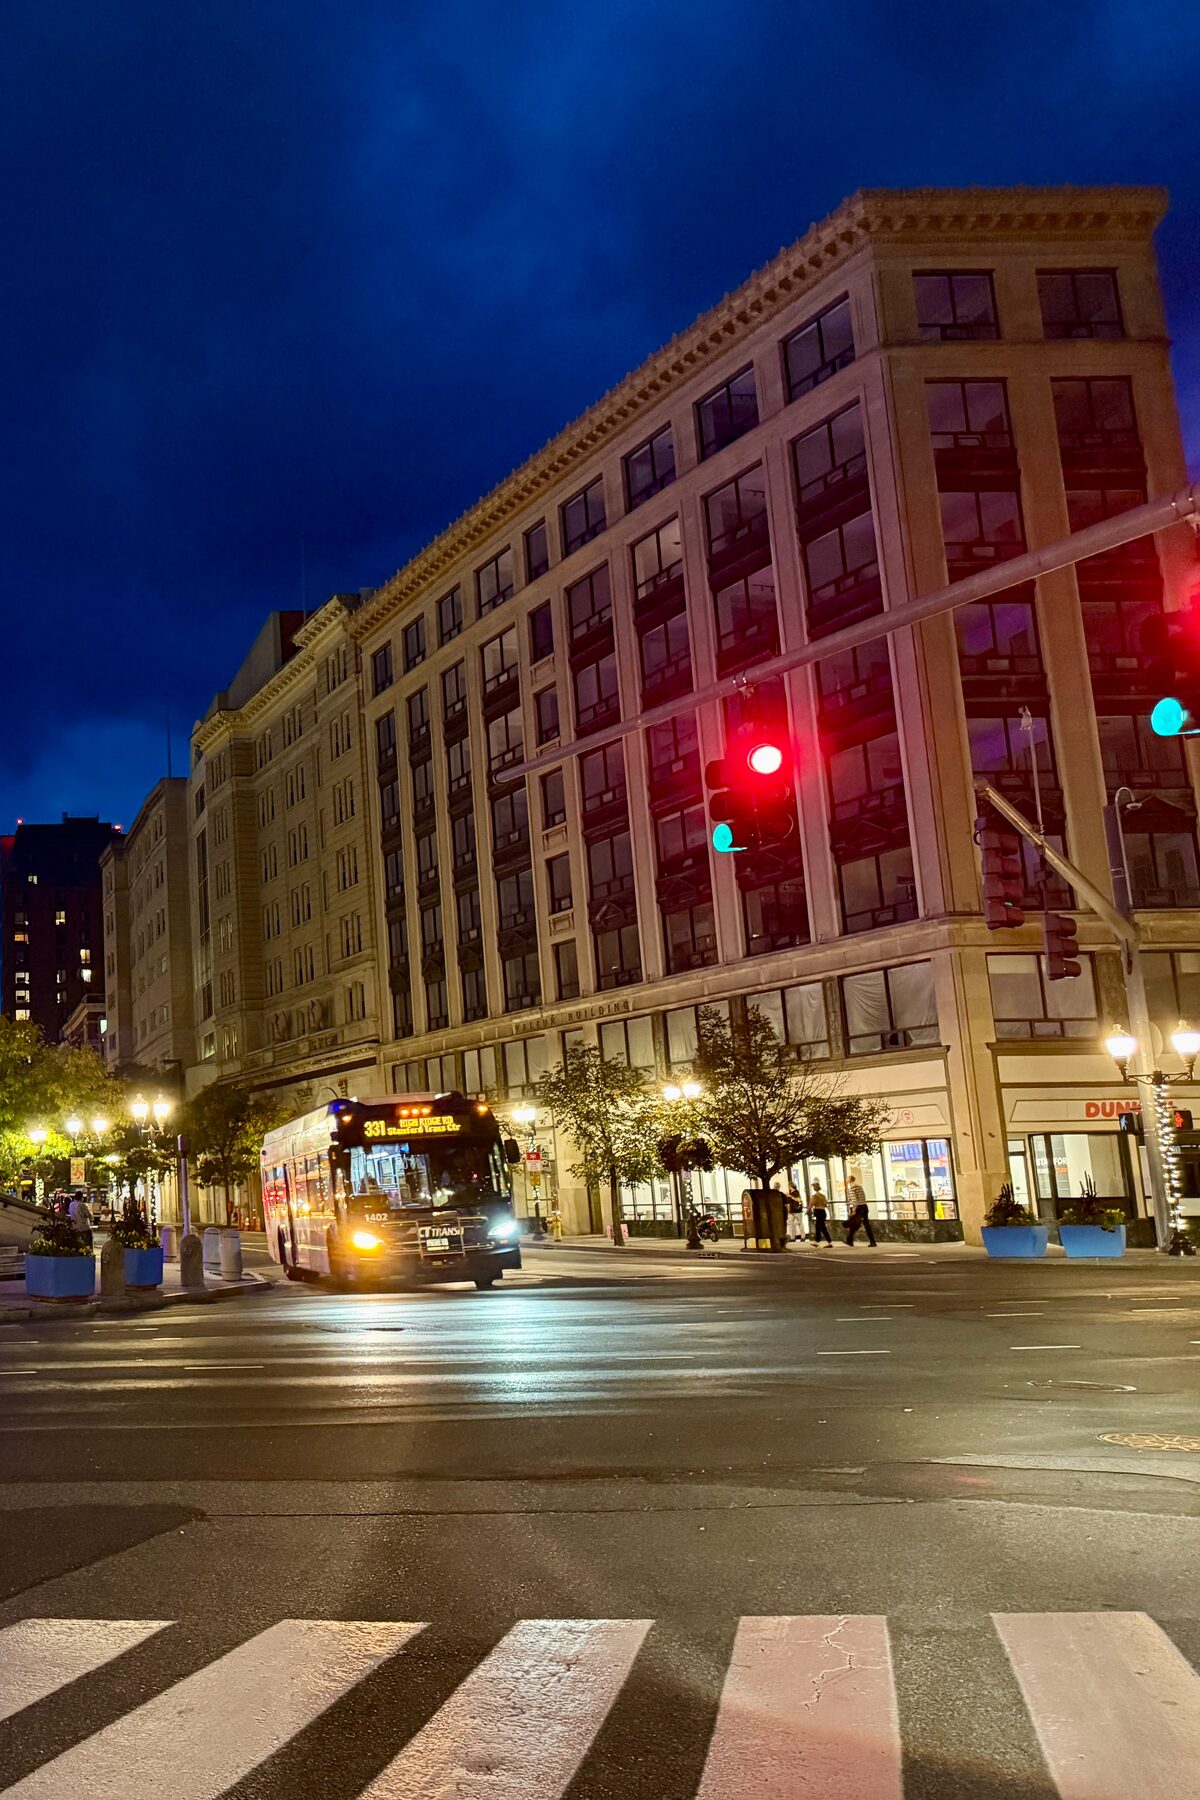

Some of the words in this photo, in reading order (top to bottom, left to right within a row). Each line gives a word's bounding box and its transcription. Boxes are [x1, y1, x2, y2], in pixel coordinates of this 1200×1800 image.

[568, 1000, 630, 1022] BUILDING
[399, 1118, 418, 1128] HIGH
[419, 1116, 442, 1126] RIDGE
[364, 1120, 386, 1137] 331
[387, 1125, 423, 1136] Stamford
[424, 1124, 446, 1133] Trans
[364, 1213, 389, 1222] 1402
